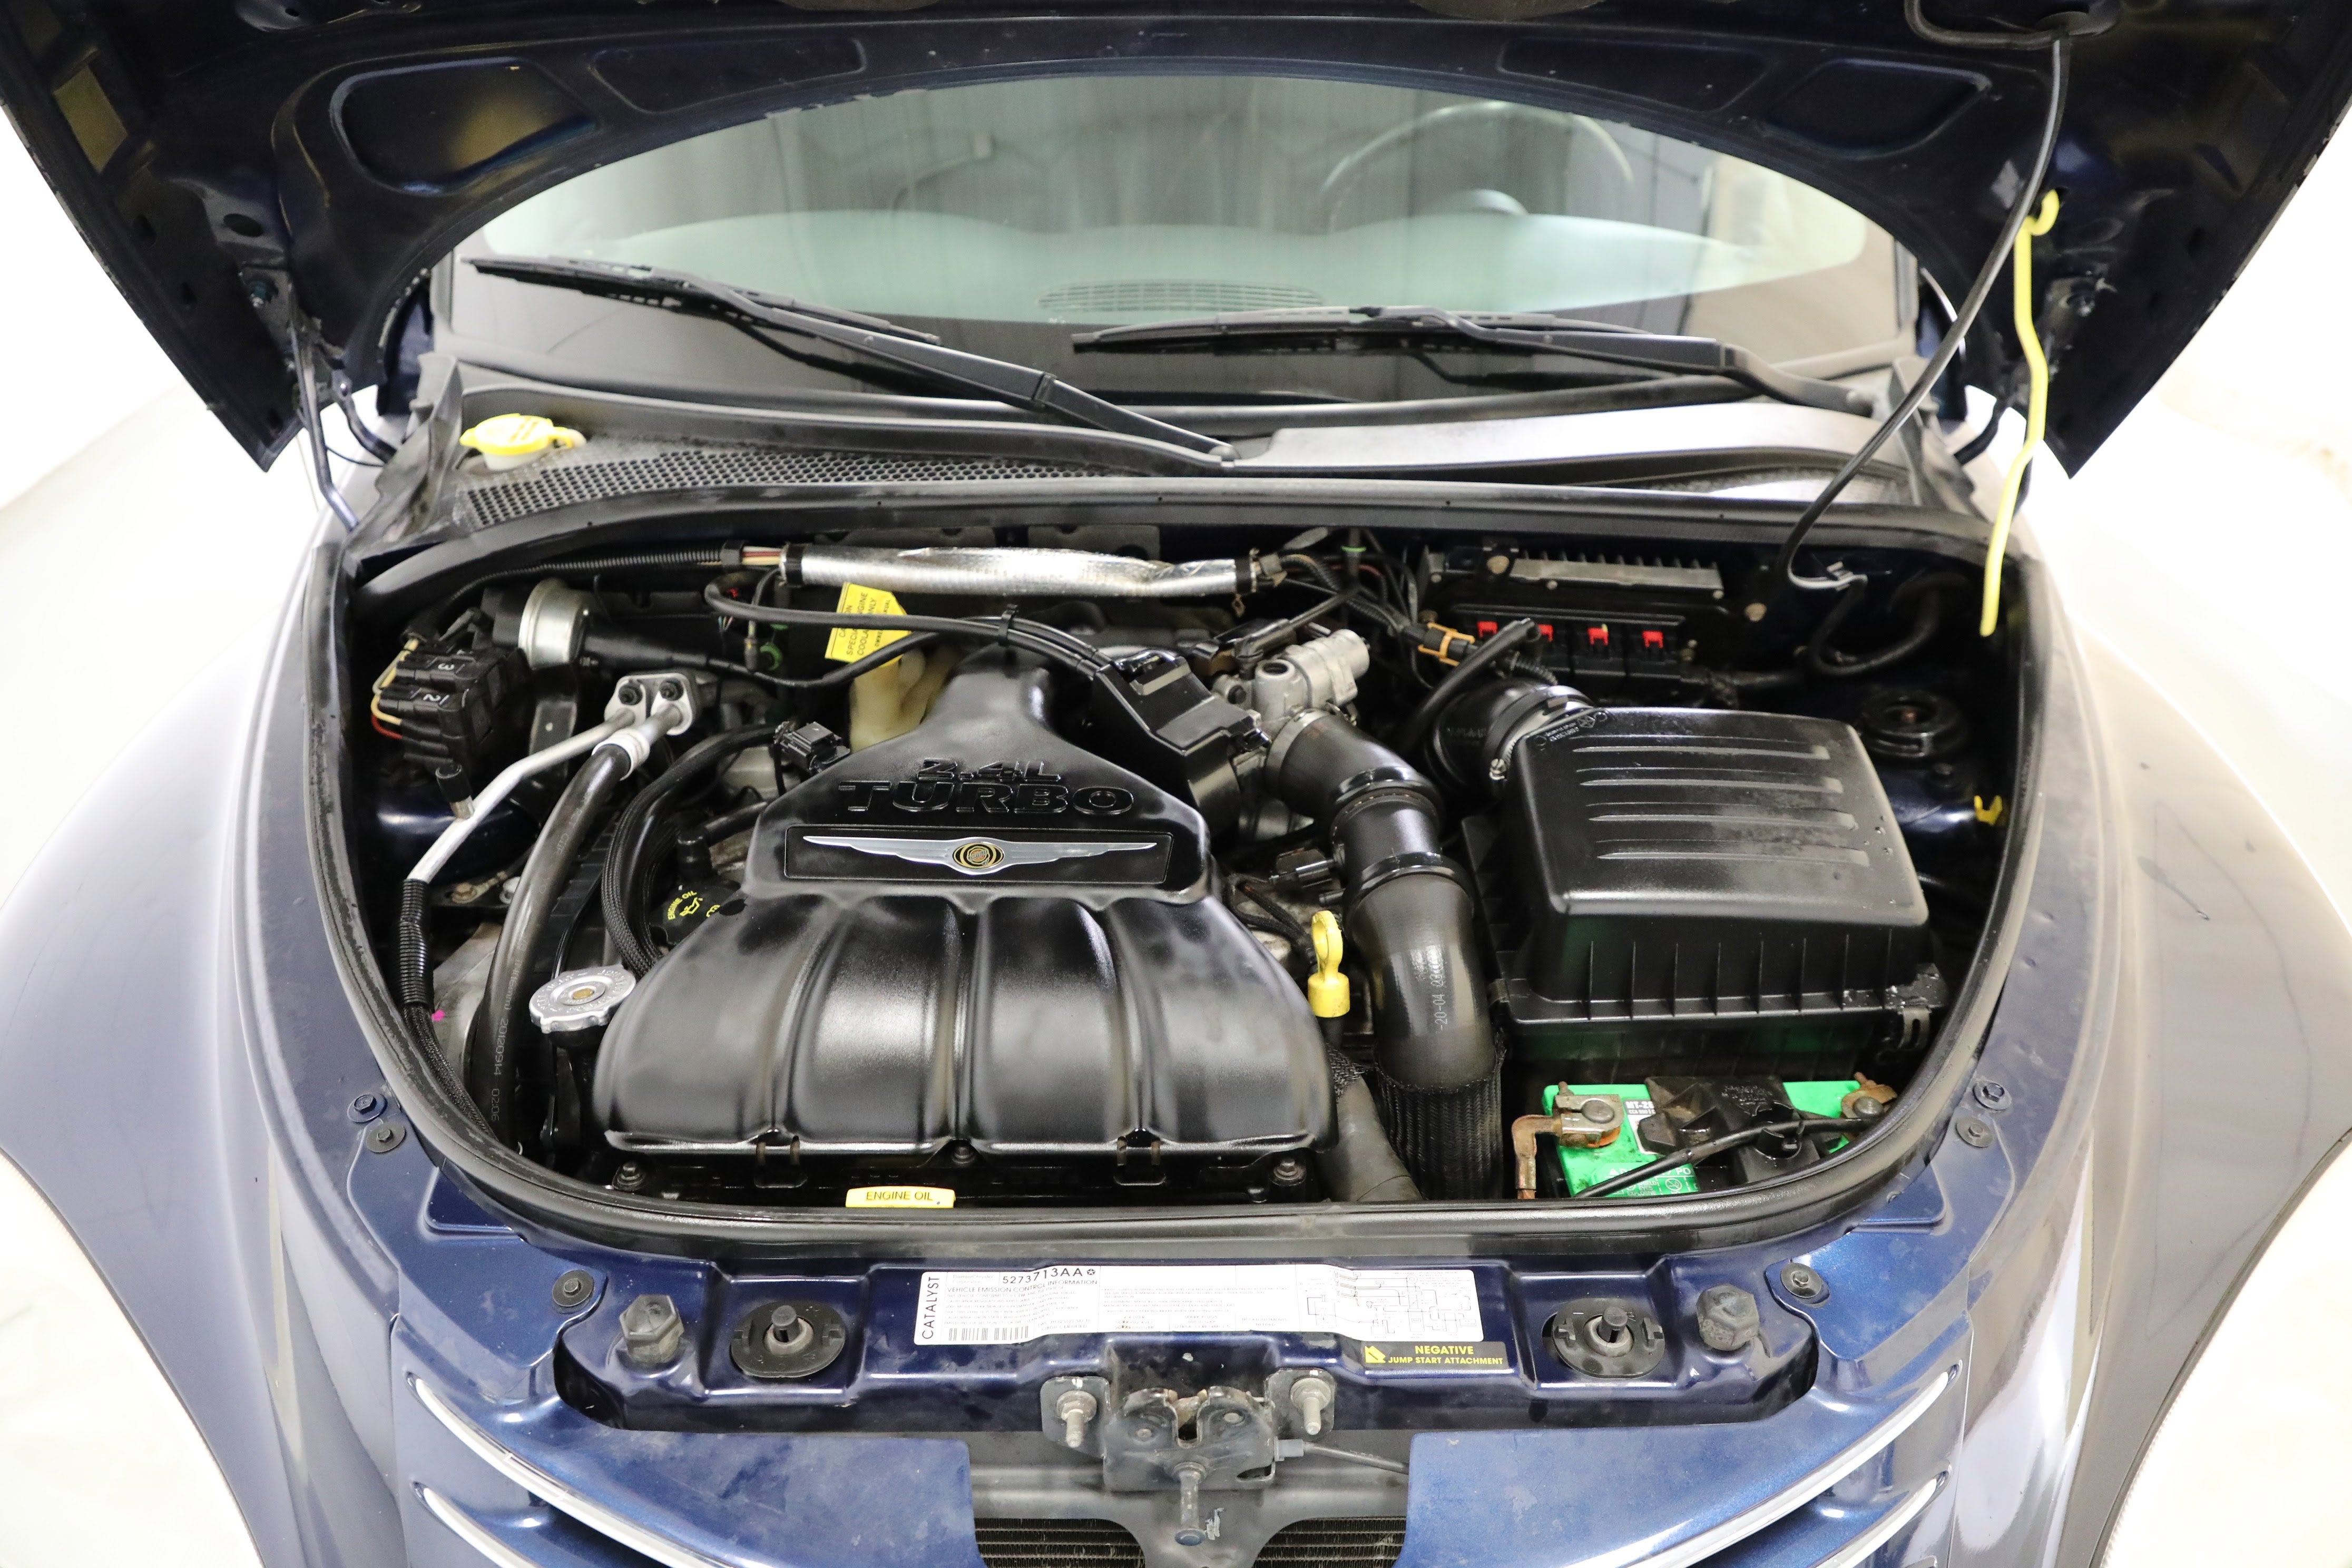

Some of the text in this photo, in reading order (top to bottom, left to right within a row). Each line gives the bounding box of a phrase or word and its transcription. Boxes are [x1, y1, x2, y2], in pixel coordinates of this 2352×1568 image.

[838, 780, 1135, 816] TURBO
[668, 890, 698, 920] ENGINE OIL
[866, 1191, 934, 1201] ENGINE OIL
[1002, 1267, 1083, 1284] 5273713AA
[1013, 1283, 1046, 1292] CONTROL
[922, 1276, 940, 1340] CATALYST
[1415, 1345, 1474, 1355] NEGATIVE
